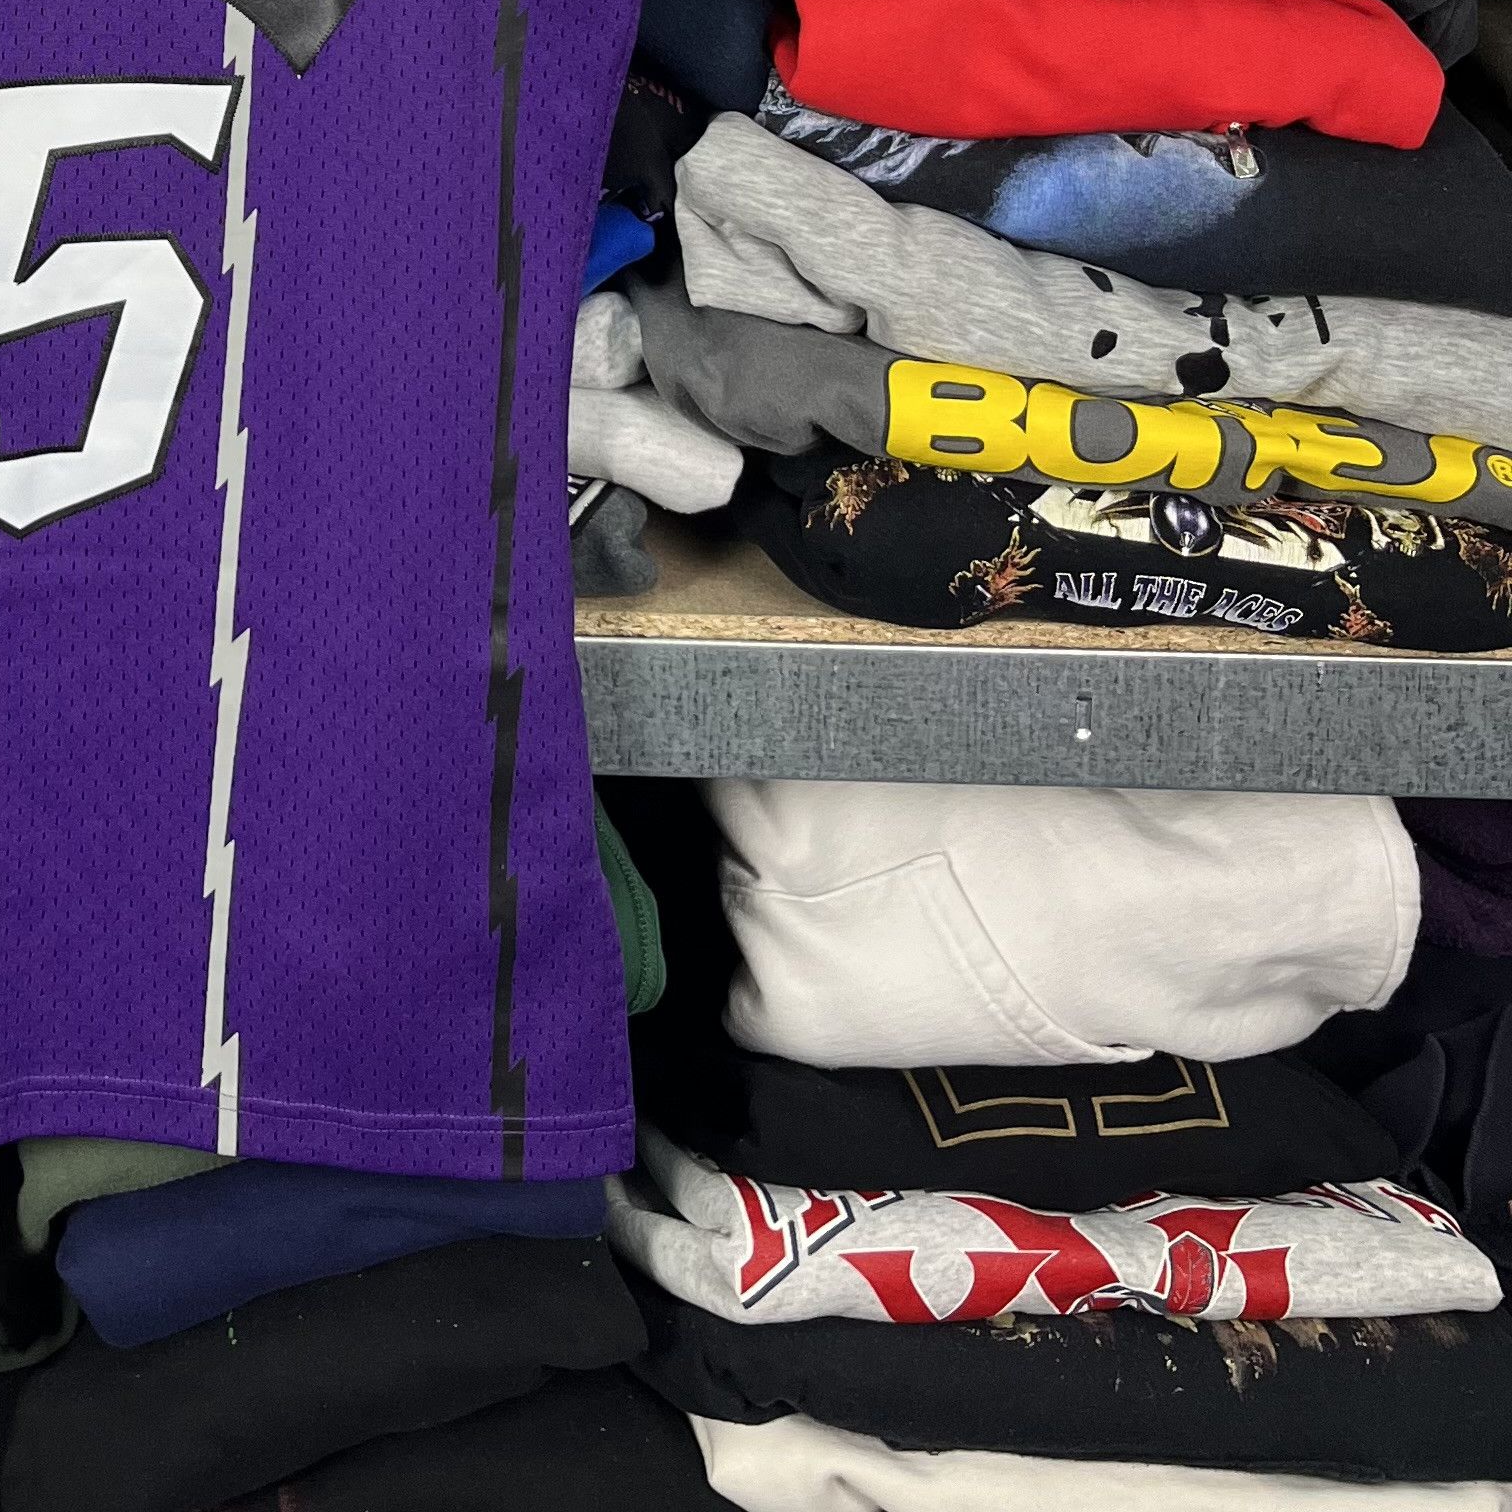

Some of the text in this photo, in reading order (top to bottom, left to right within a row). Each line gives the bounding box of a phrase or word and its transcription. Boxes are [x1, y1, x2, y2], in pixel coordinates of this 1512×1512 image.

[1053, 572, 1304, 632] ALL THE ACES
